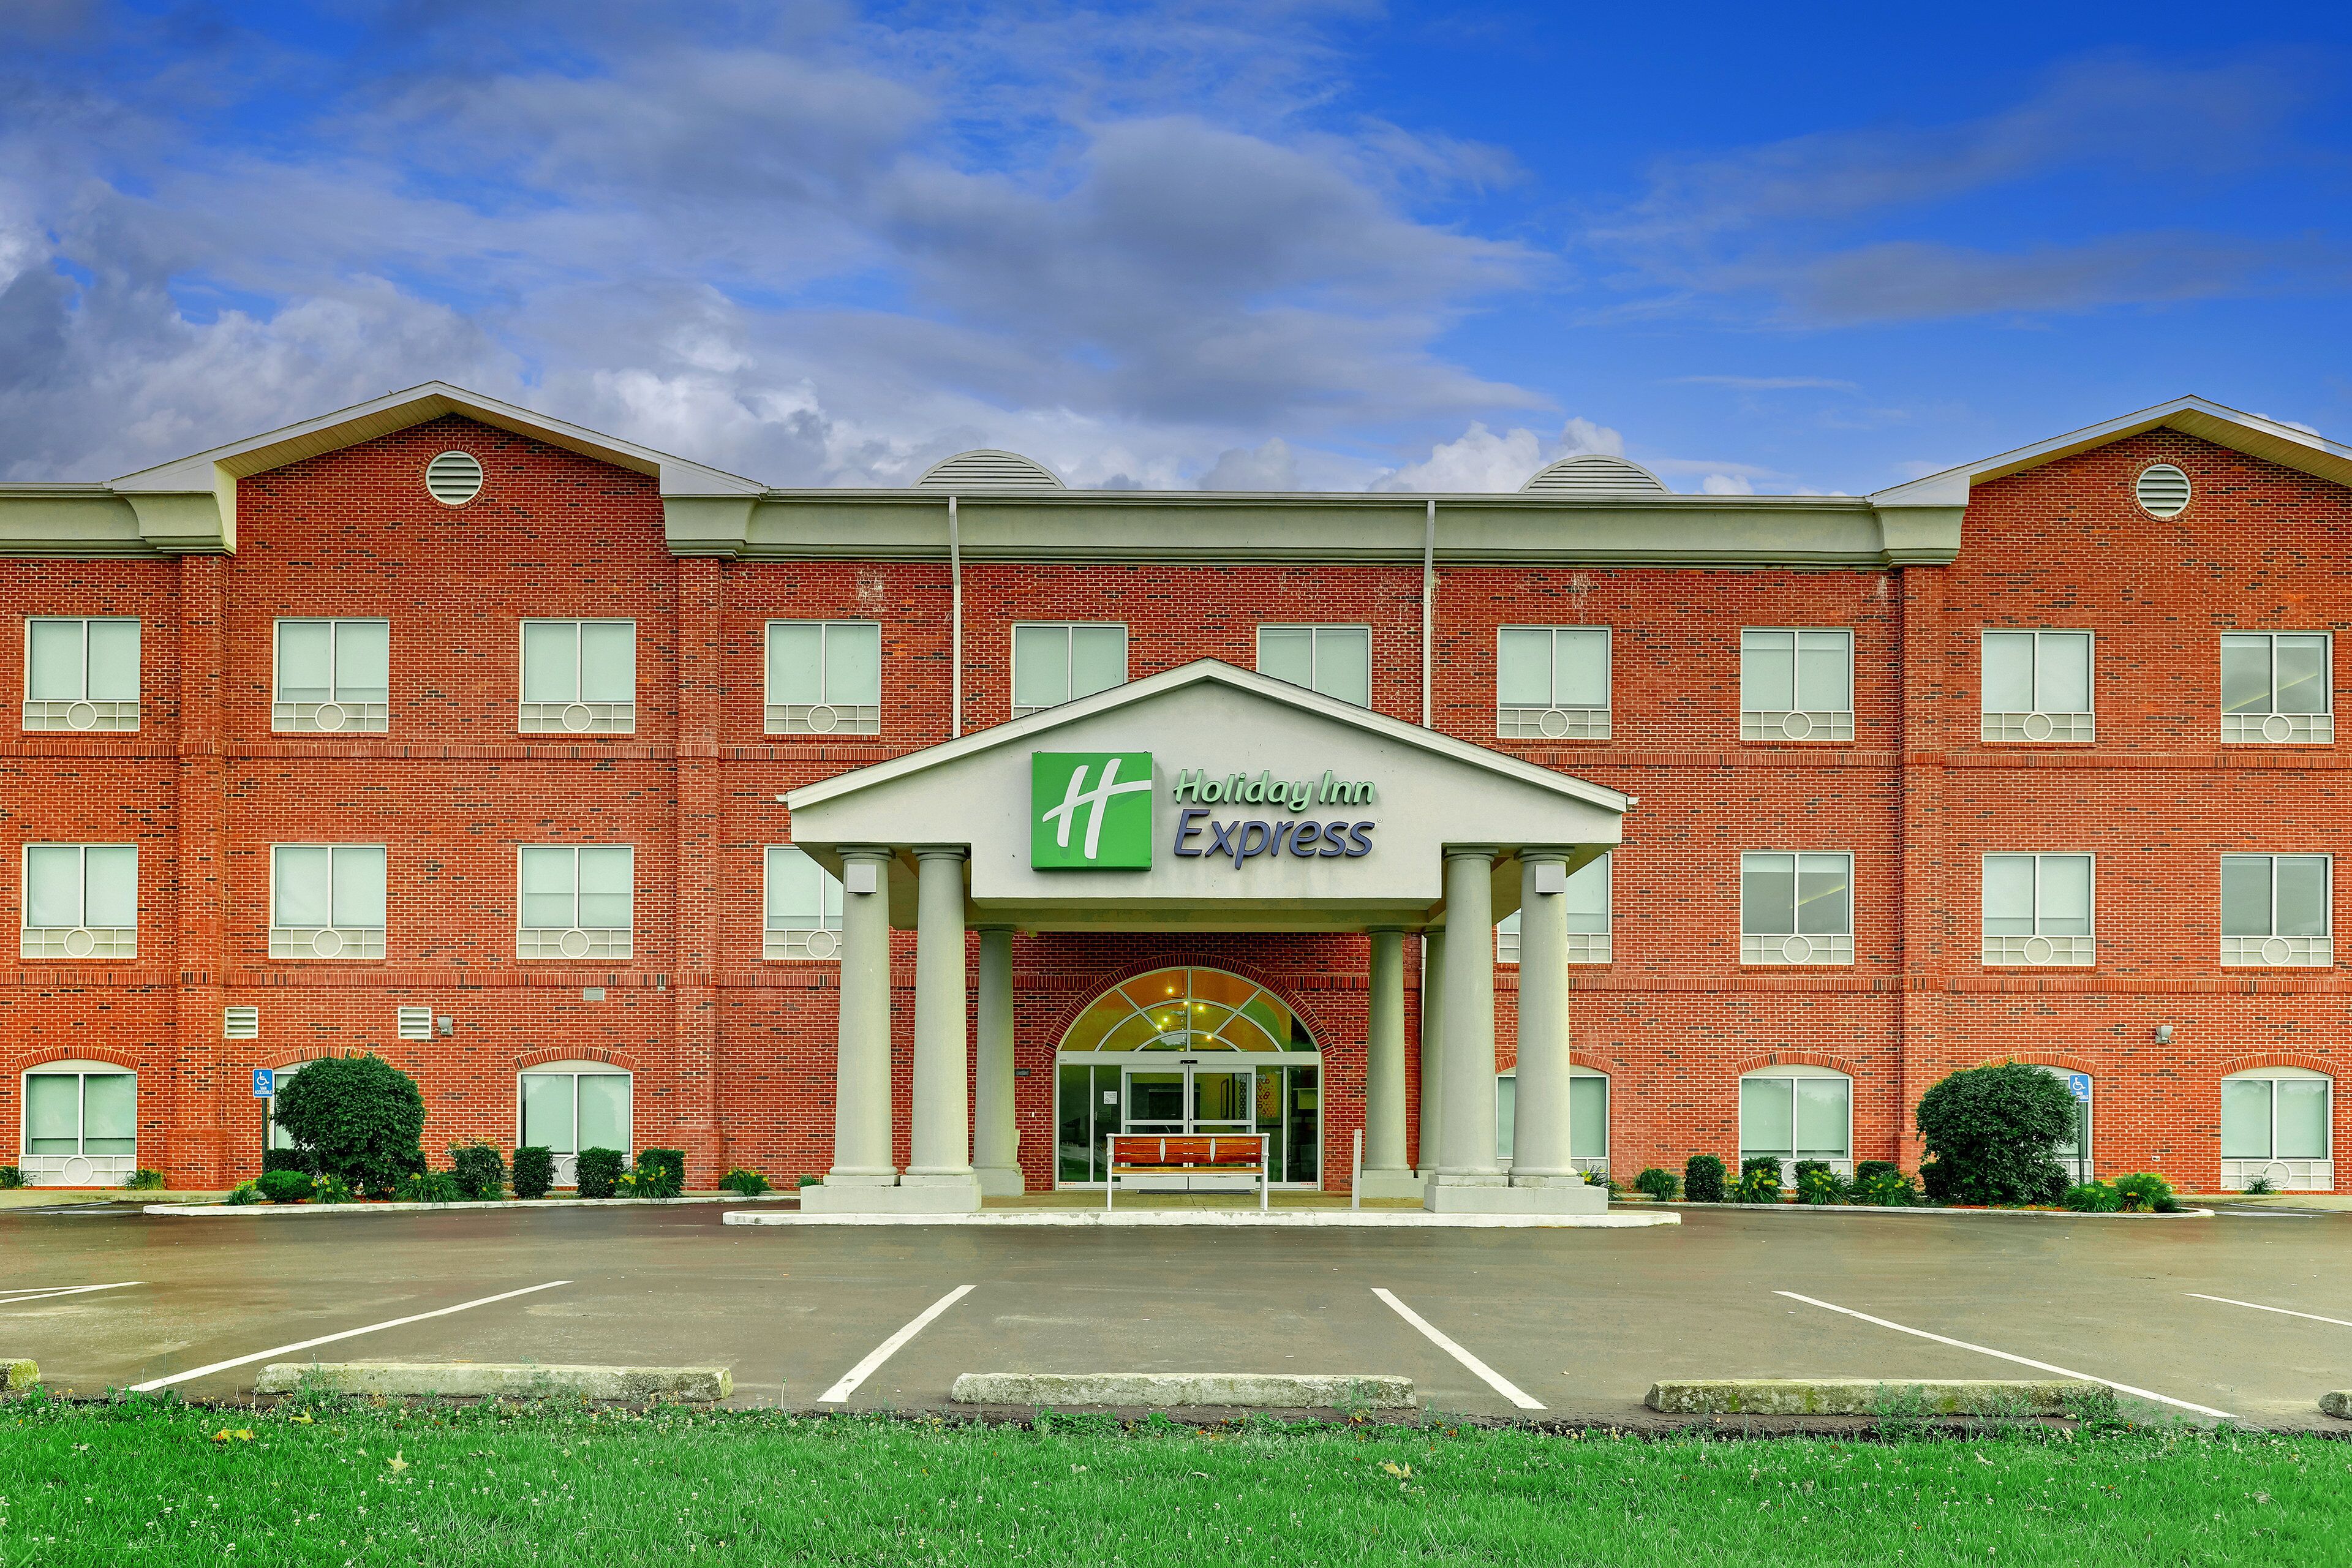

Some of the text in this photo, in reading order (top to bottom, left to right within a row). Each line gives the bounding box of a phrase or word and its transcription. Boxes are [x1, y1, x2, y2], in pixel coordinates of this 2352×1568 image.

[1173, 769, 1376, 813] Holiday Inn
[1174, 809, 1376, 870] Express
